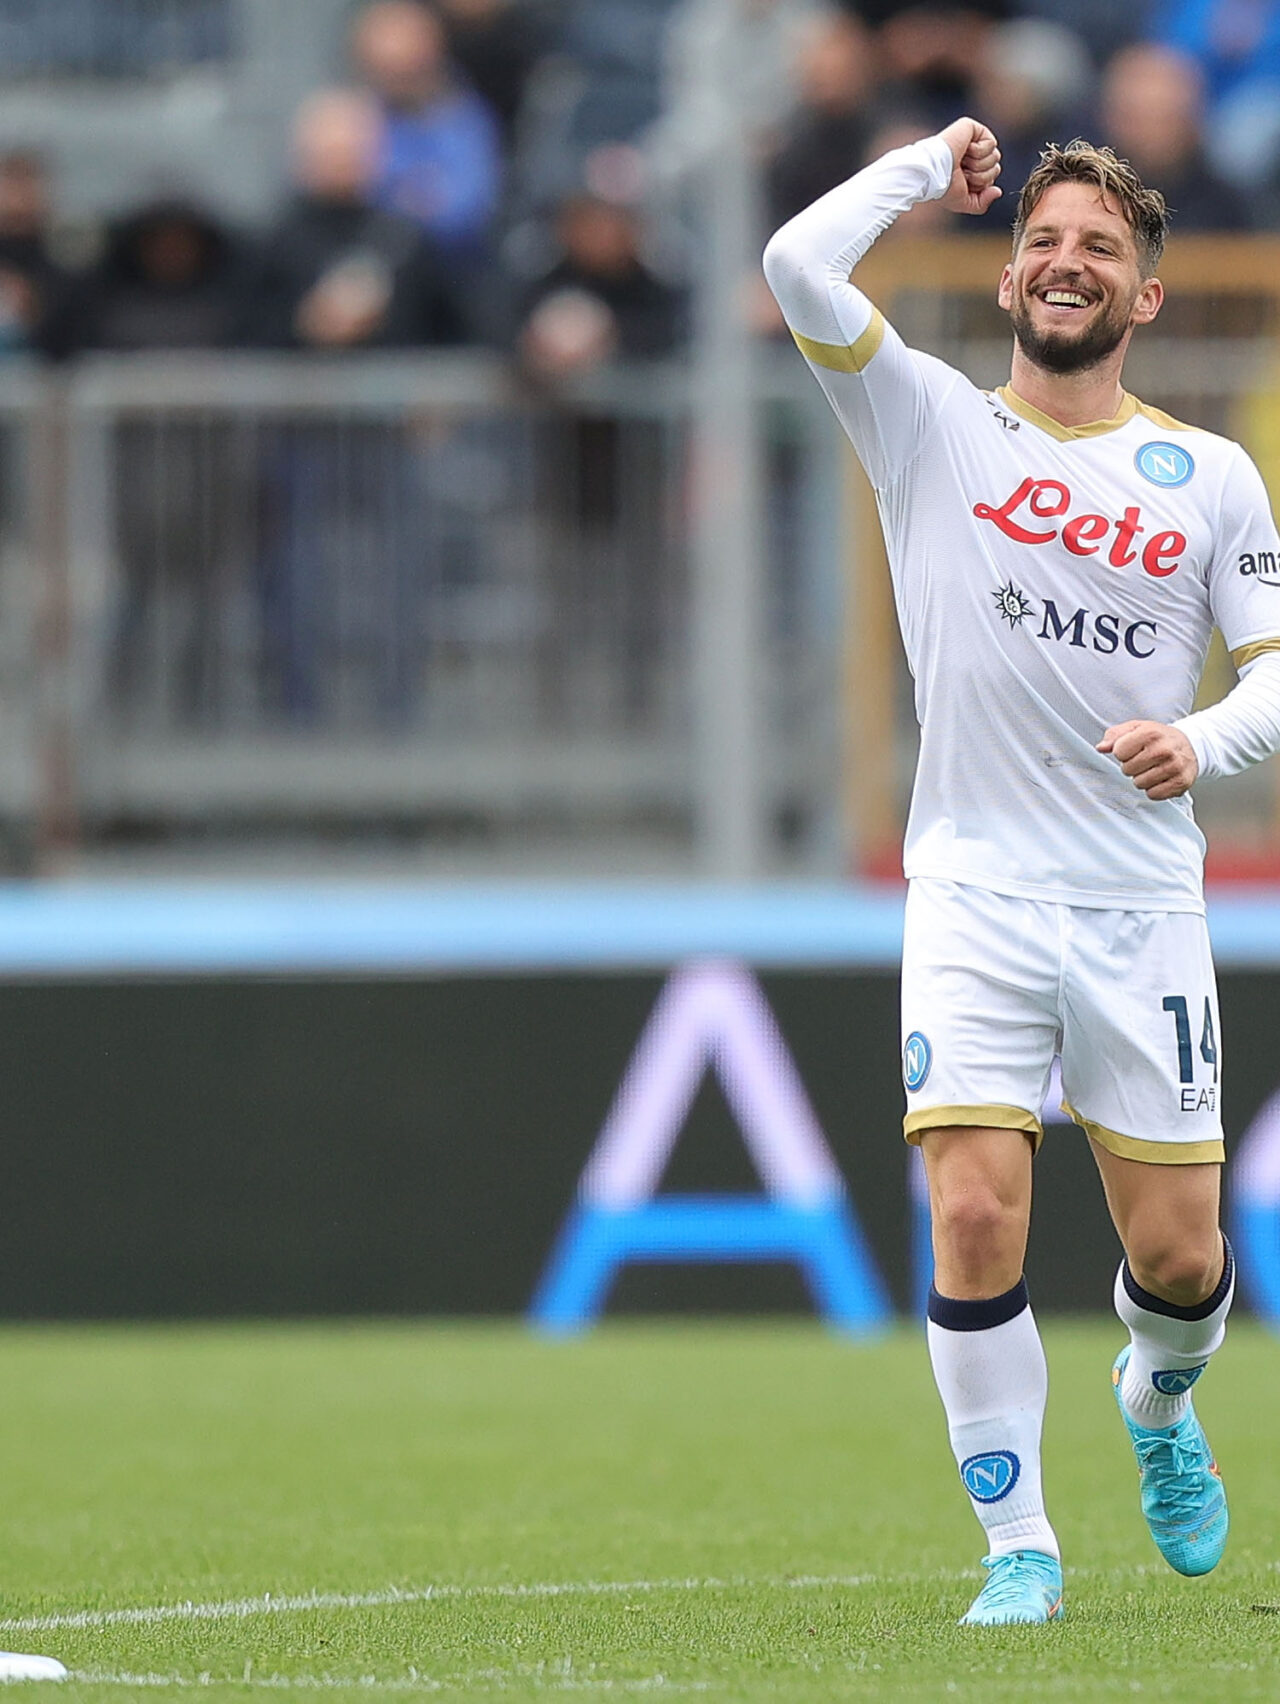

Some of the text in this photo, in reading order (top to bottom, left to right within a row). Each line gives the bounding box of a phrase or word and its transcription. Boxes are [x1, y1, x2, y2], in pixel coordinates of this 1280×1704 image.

[1151, 454, 1179, 477] N
[973, 477, 1187, 578] Lete
[1037, 599, 1158, 659] MSC
[1162, 995, 1218, 1084] 14
[972, 1462, 1001, 1490] N
